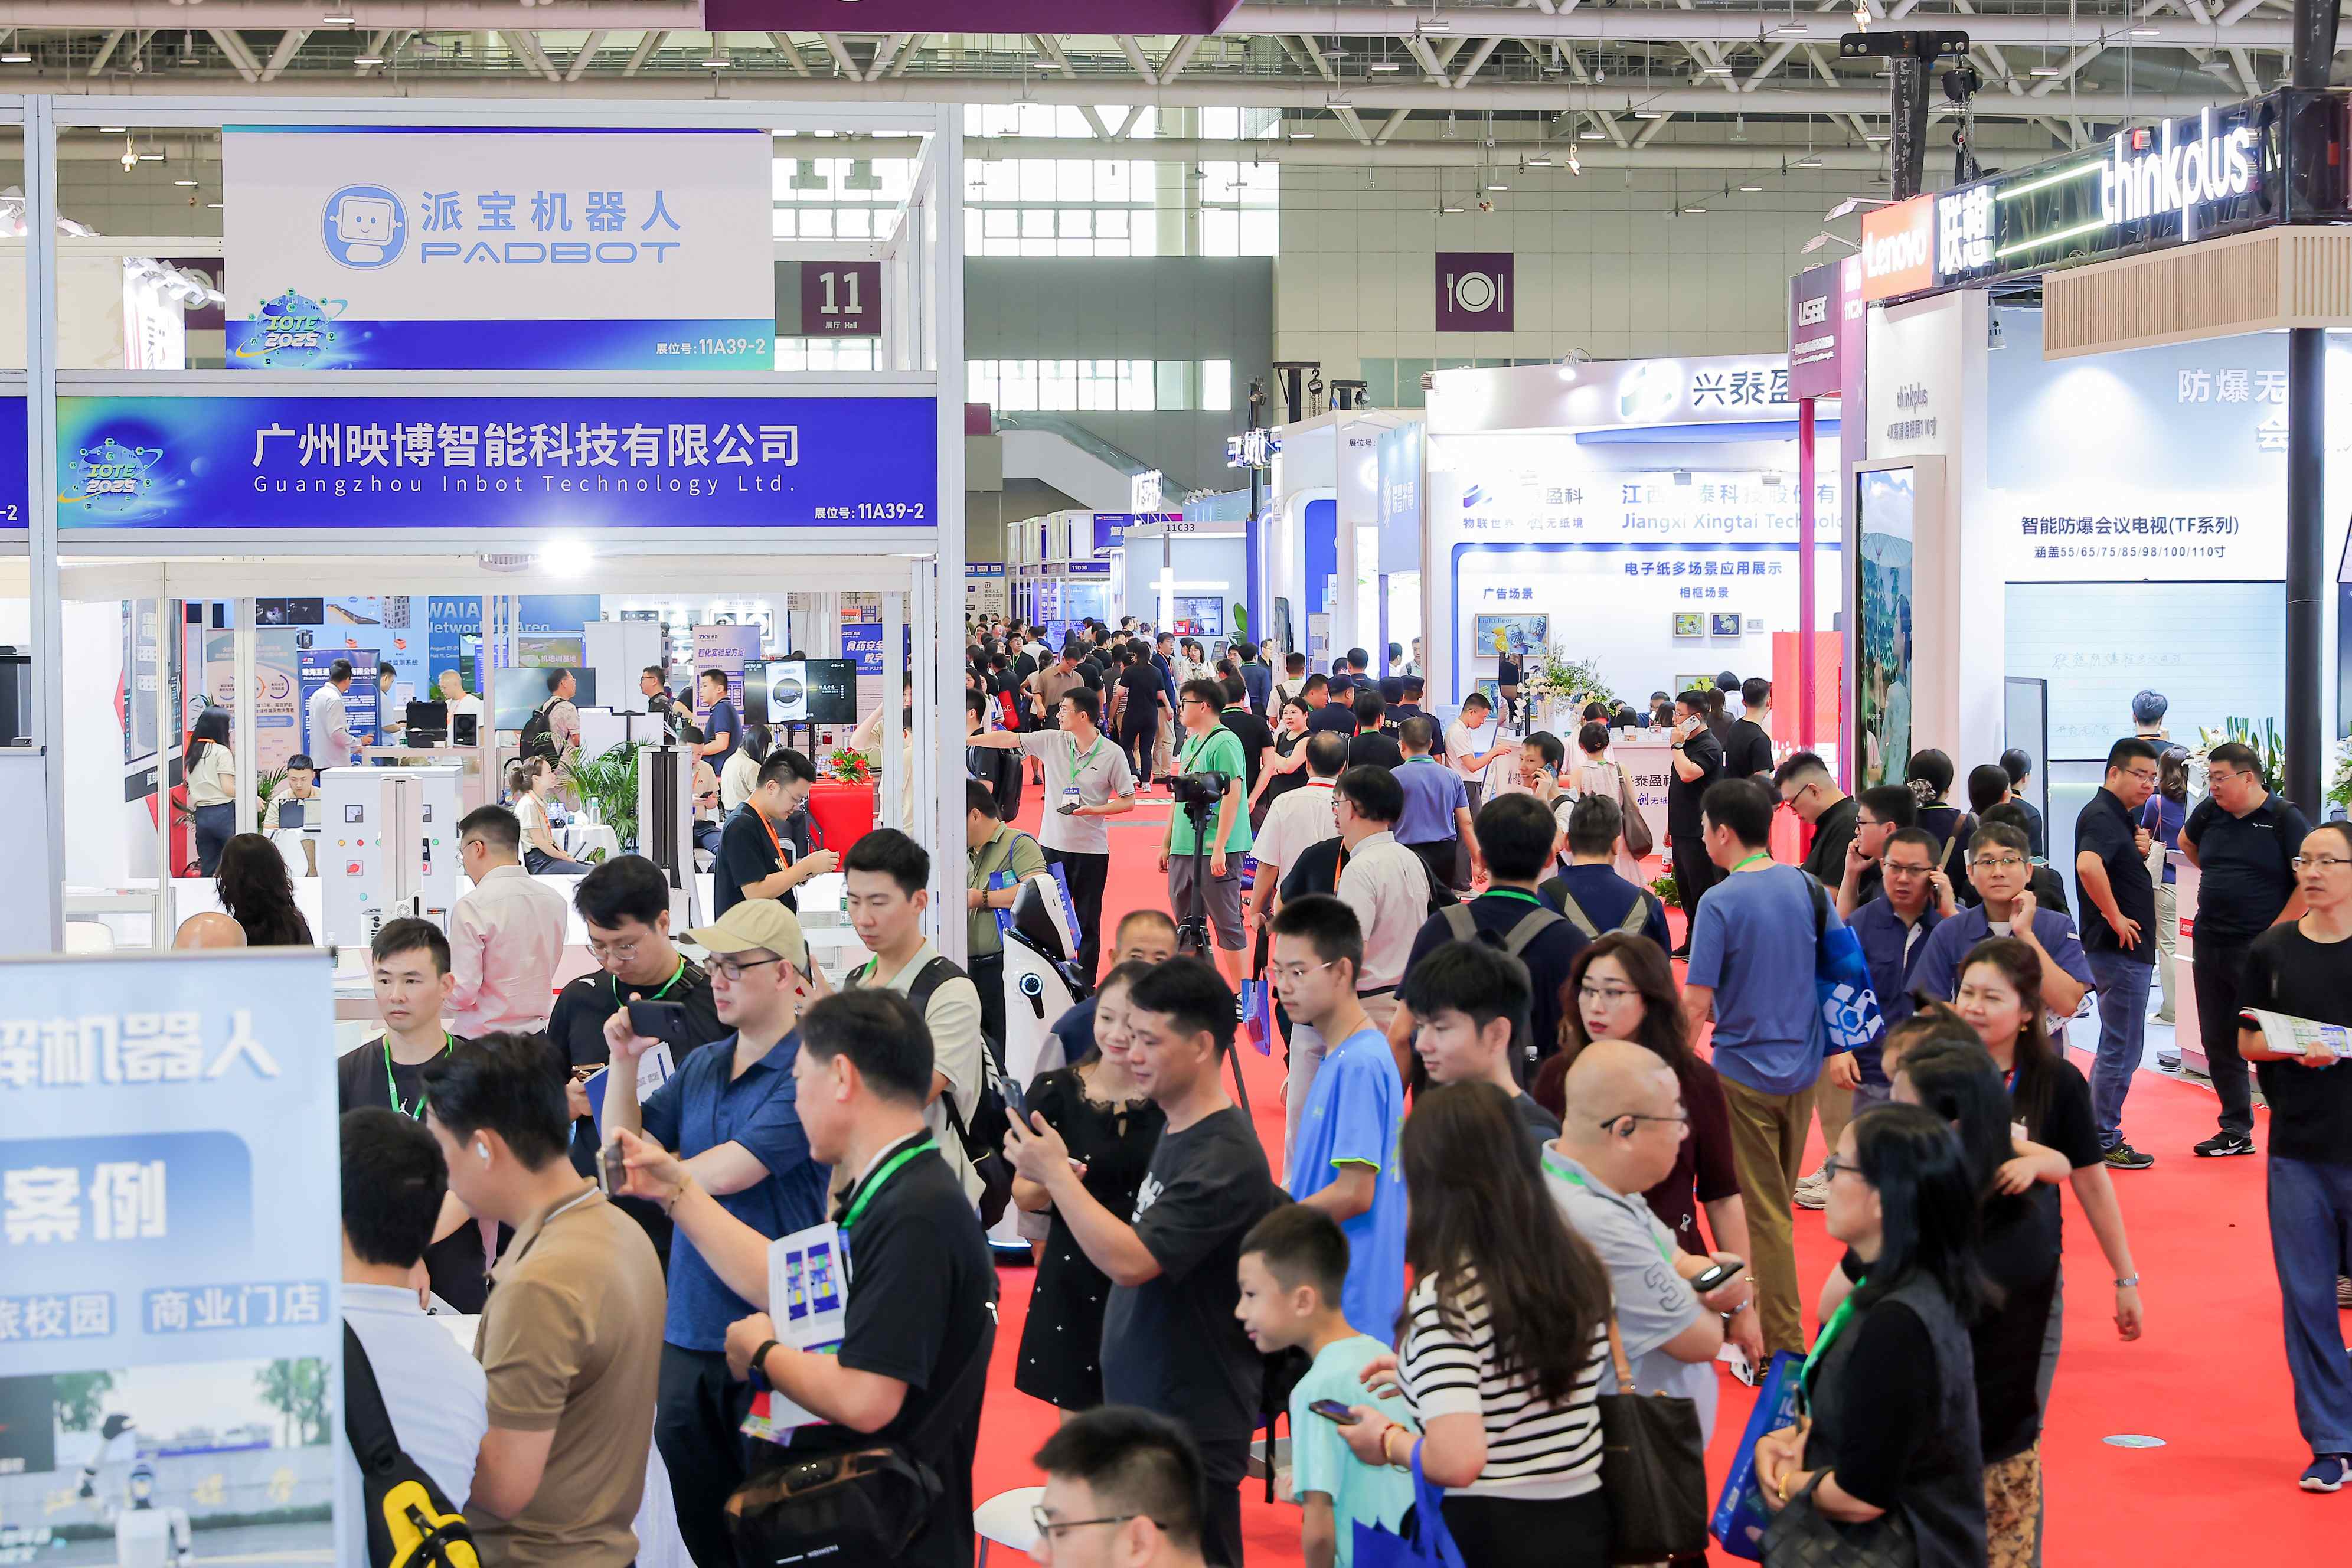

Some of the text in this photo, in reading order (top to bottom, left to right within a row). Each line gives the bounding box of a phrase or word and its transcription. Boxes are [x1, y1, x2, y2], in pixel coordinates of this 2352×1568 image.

[2100, 106, 2250, 243] thinkplus
[420, 190, 681, 233] 派宝机器人
[1938, 185, 1994, 276] 联想
[421, 242, 681, 264] PADBOT
[1866, 226, 1928, 279] Lenovo
[819, 272, 863, 314] 11
[266, 315, 320, 331] IOTE
[825, 321, 841, 329] 展厅
[264, 332, 321, 347] 2025
[1897, 382, 1928, 414] thinkplus
[252, 422, 799, 468] 广州映博智能科技有限公司
[87, 463, 137, 478] IOTE
[85, 479, 138, 493] 2025
[253, 475, 795, 496] Guangzhou Inbot Technology Ltd.
[1622, 512, 1687, 533] Jiangxi
[1693, 512, 1758, 533] Xingtai
[2021, 515, 2239, 535] 智能防爆会议电视(TF系列)
[2034, 545, 2226, 558] 涵盖55/65/75/85/98/100/110寸
[1624, 561, 1782, 576] 电子纸多场景应用展示
[1482, 587, 1533, 600] 广告场景
[1679, 586, 1729, 599] 相框场景
[3, 1161, 168, 1244] 案例
[150, 1282, 322, 1331] 商业门店
